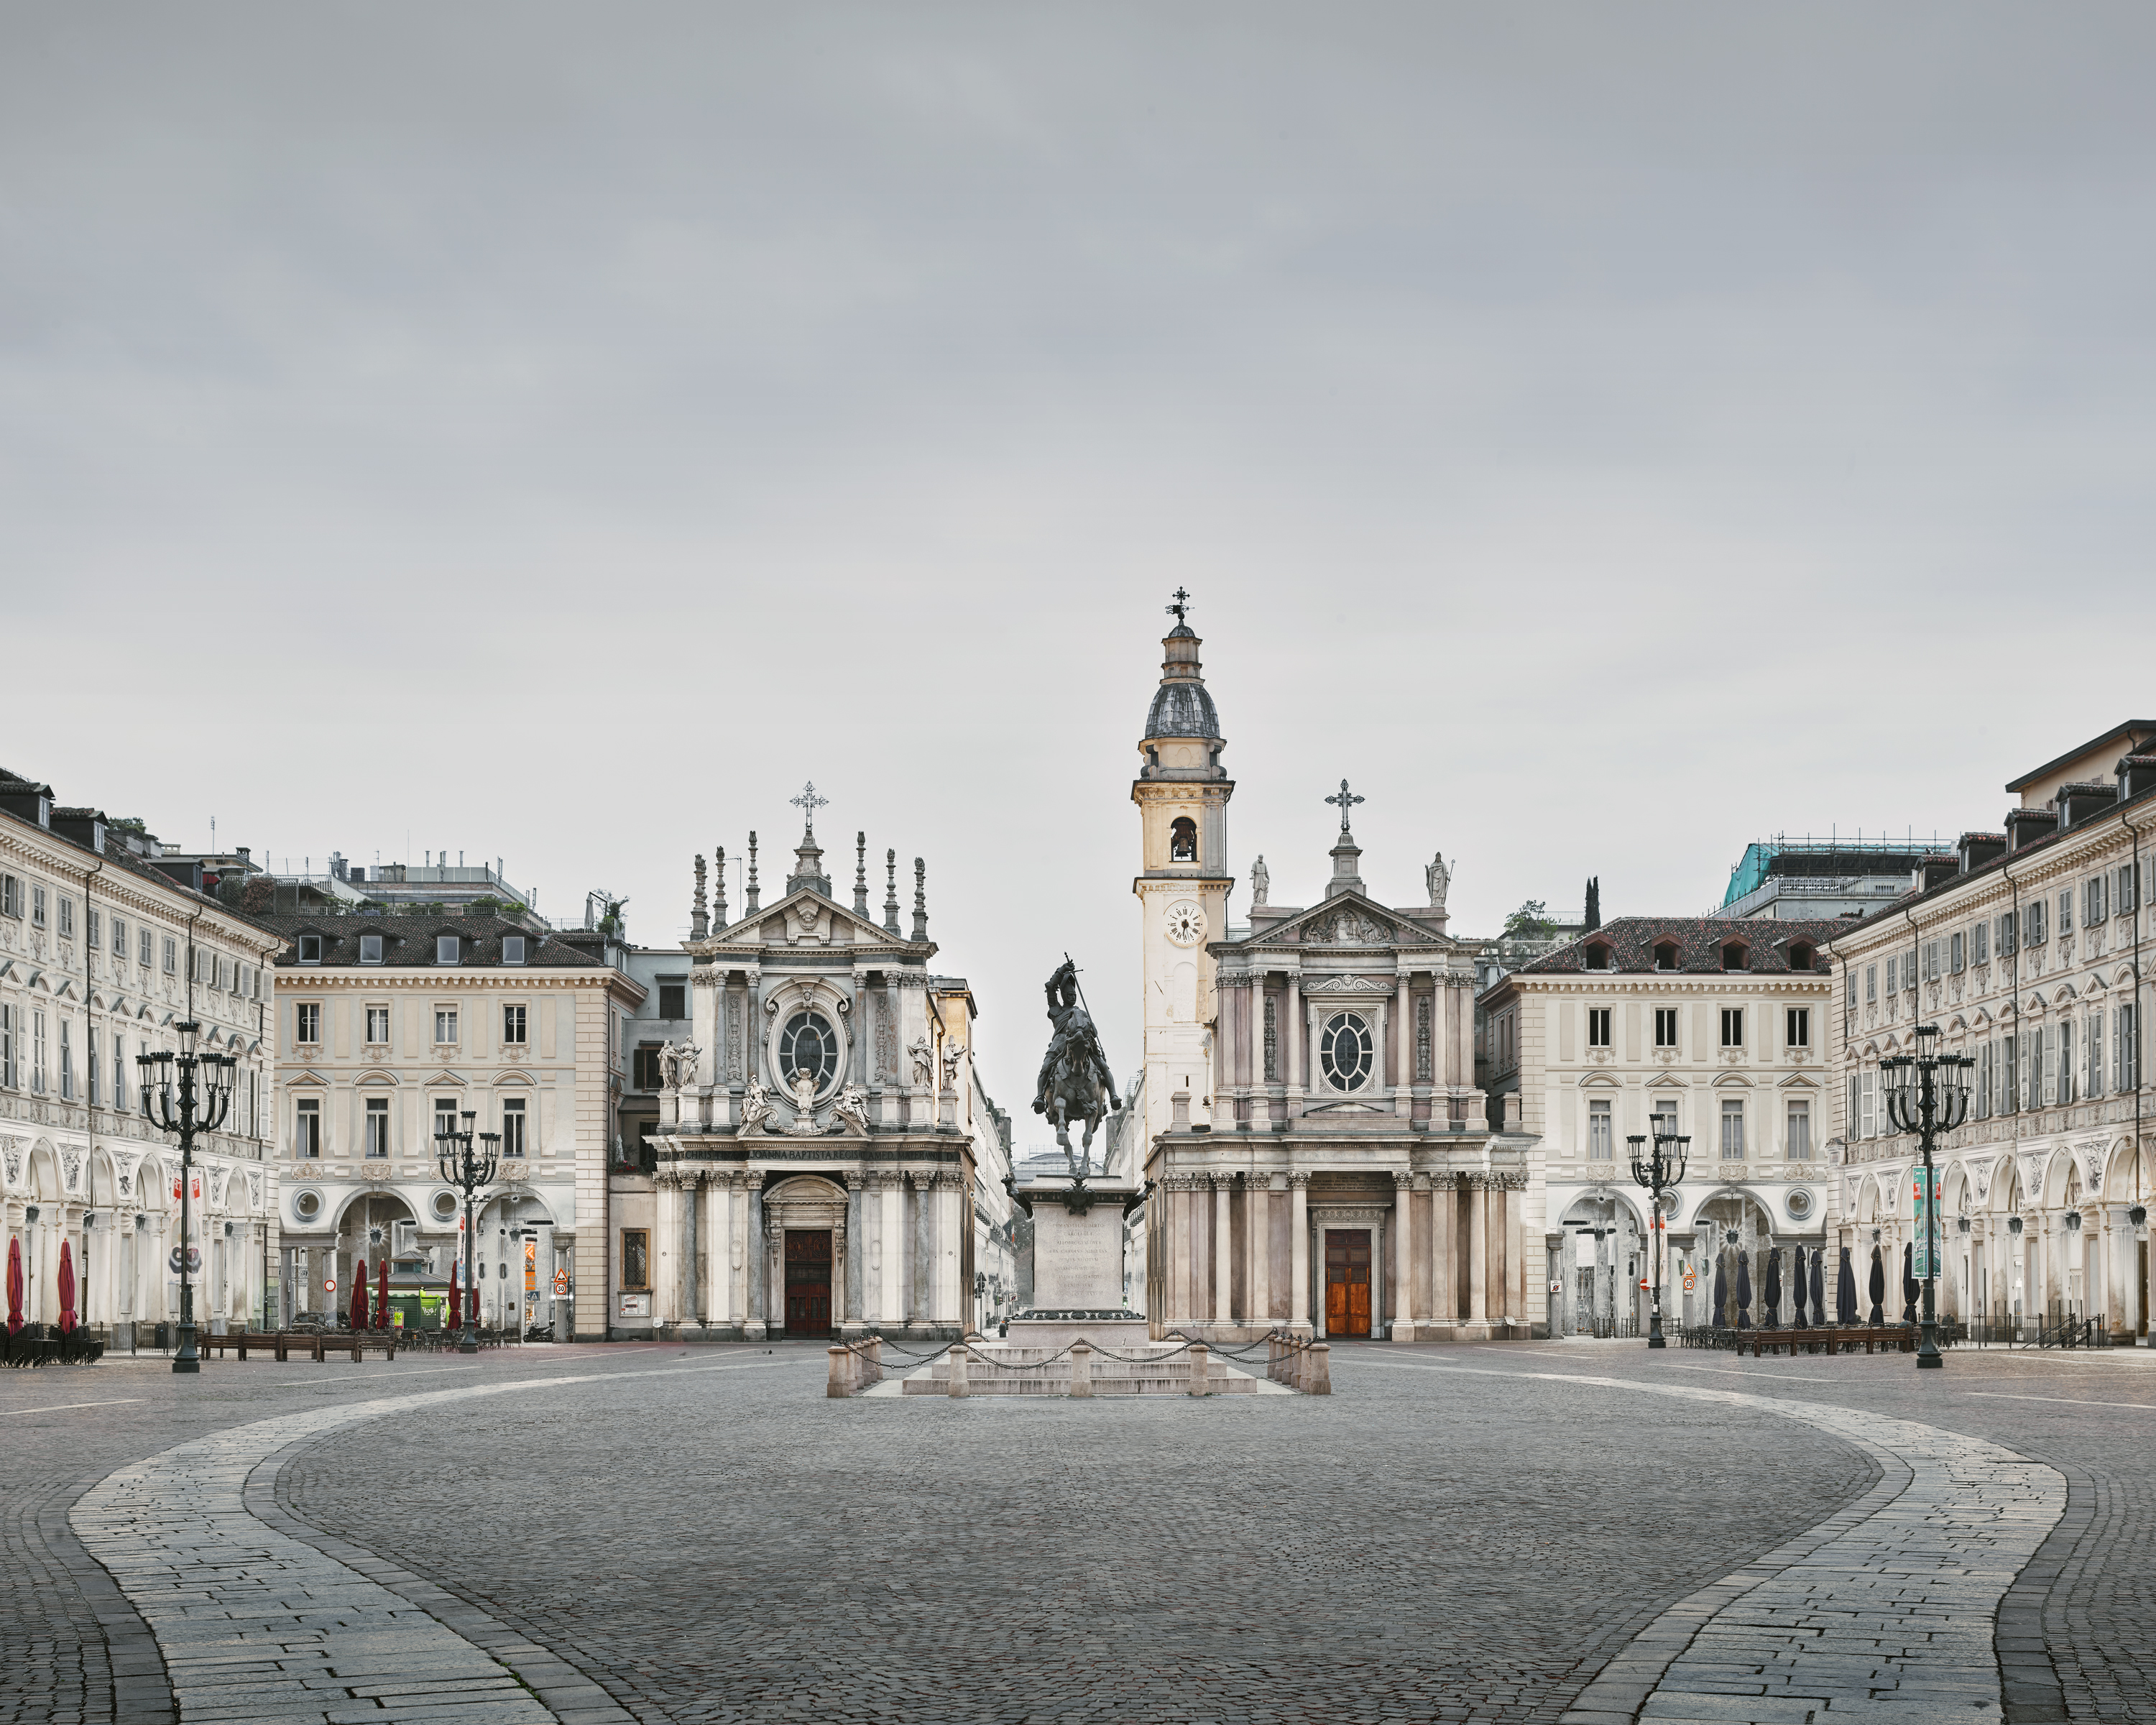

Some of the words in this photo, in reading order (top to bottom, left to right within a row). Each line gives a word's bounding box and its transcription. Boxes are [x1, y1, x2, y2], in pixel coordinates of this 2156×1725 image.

[750, 1151, 787, 1159] JOANNA
[789, 1151, 832, 1159] BAPTISTA
[833, 1151, 858, 1159] REGIS
[898, 1151, 924, 1160] MATER
